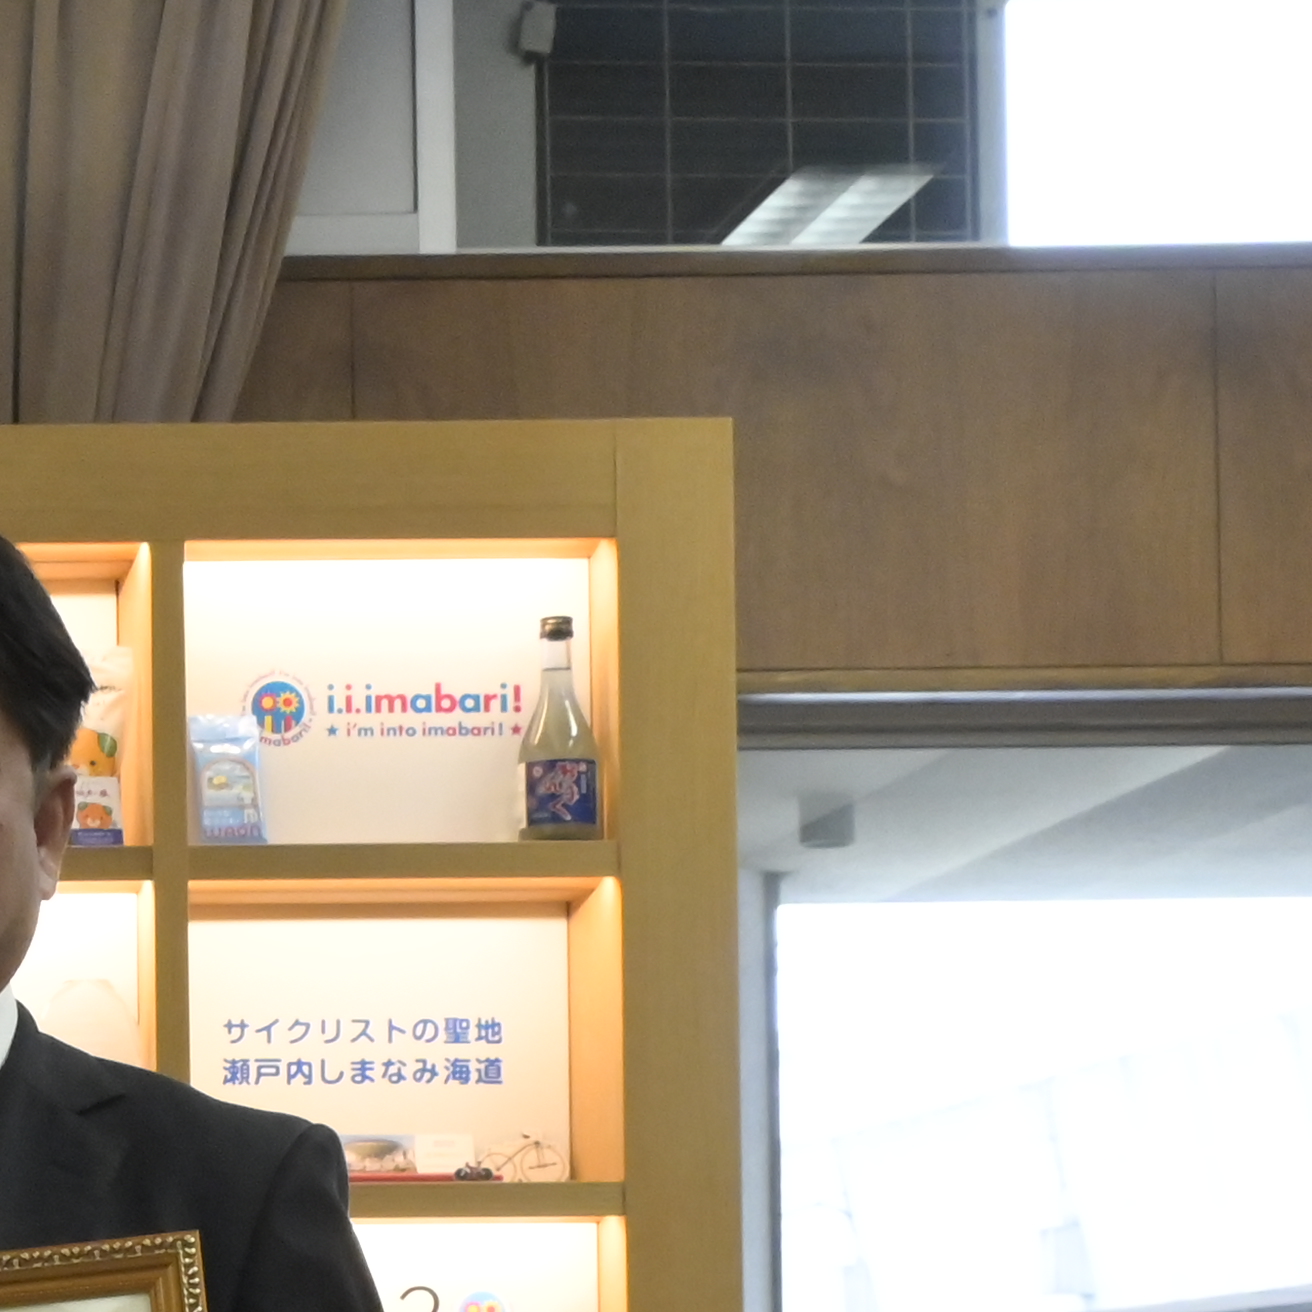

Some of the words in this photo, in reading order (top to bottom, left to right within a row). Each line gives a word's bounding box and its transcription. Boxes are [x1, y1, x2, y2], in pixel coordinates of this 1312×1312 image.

[326, 682, 523, 715] i.i.imabari!
[346, 721, 375, 737] i'm
[379, 721, 417, 737] into
[422, 721, 504, 737] imabari!
[223, 1016, 503, 1046] サイクリストの聖地
[222, 1056, 504, 1087] 瀬戸内しまなみ海道
